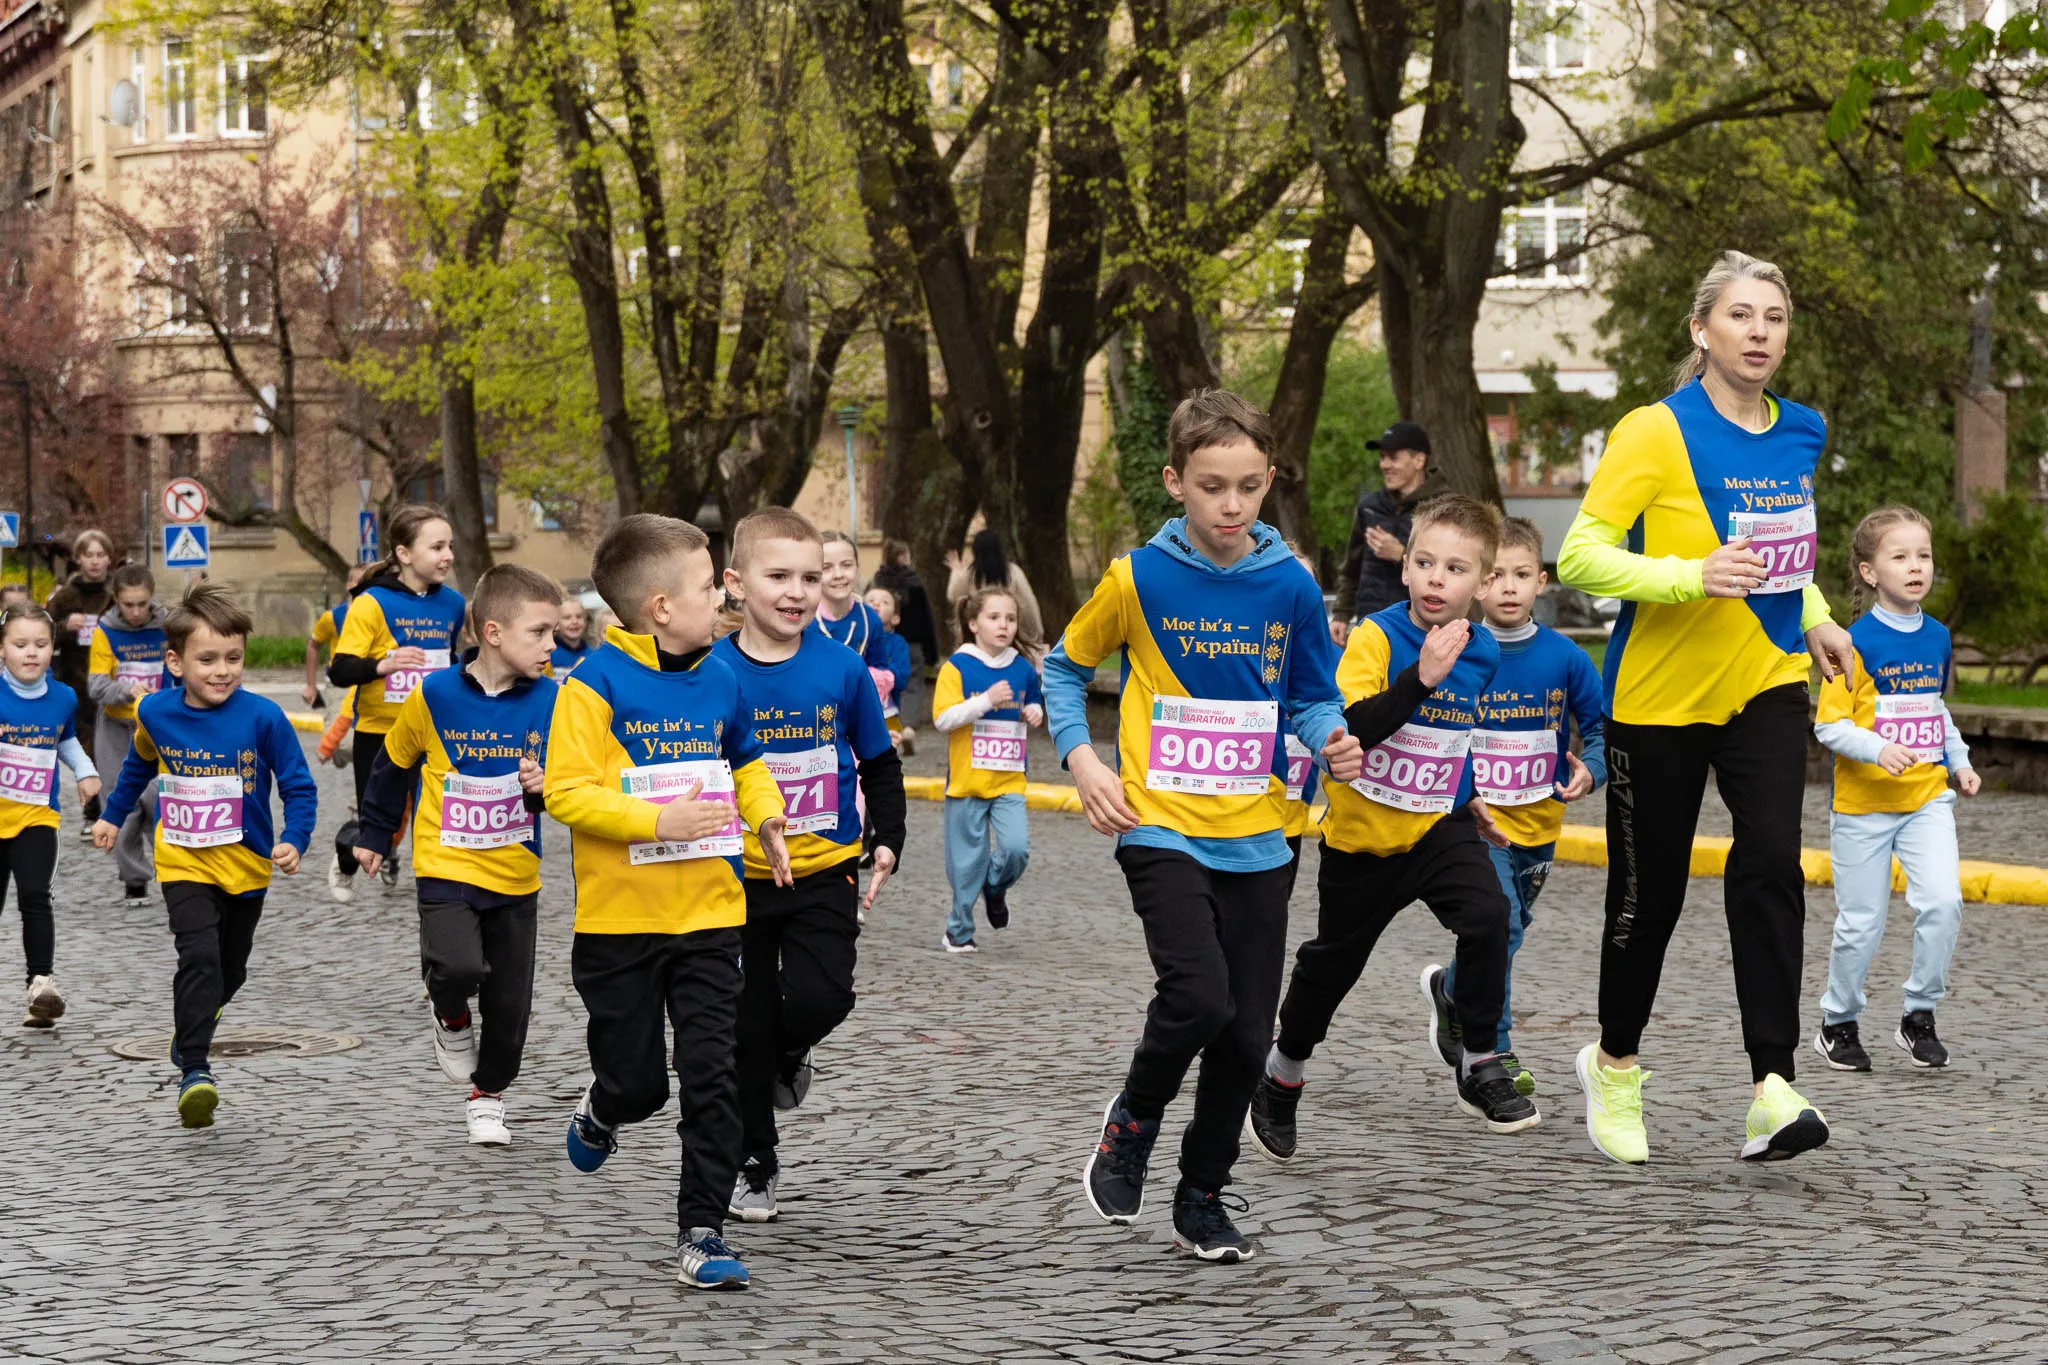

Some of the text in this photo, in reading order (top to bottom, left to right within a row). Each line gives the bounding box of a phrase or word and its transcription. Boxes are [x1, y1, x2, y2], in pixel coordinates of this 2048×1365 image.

[1724, 477, 1752, 489] Моє
[1741, 492, 1804, 511] Україна
[1745, 541, 1810, 574] 070
[1162, 617, 1196, 631] Моє
[1178, 635, 1260, 659] Україна
[1181, 713, 1236, 725] MARATHON
[1477, 704, 1545, 723] Україна
[444, 729, 468, 741] Моє
[624, 720, 660, 735] Моє
[1880, 720, 1943, 746] 9058
[160, 745, 183, 758] Моє
[456, 743, 522, 761] Україна
[642, 736, 715, 759] Україна
[973, 739, 1021, 759] 9029
[1160, 734, 1263, 771] 9063
[172, 761, 236, 779] Україна
[1365, 748, 1453, 792] 9062
[1473, 758, 1547, 786] 9010
[1610, 746, 1634, 808] EA7
[463, 786, 503, 796] MARATHON
[166, 802, 233, 829] 9072
[449, 799, 528, 831] 9064
